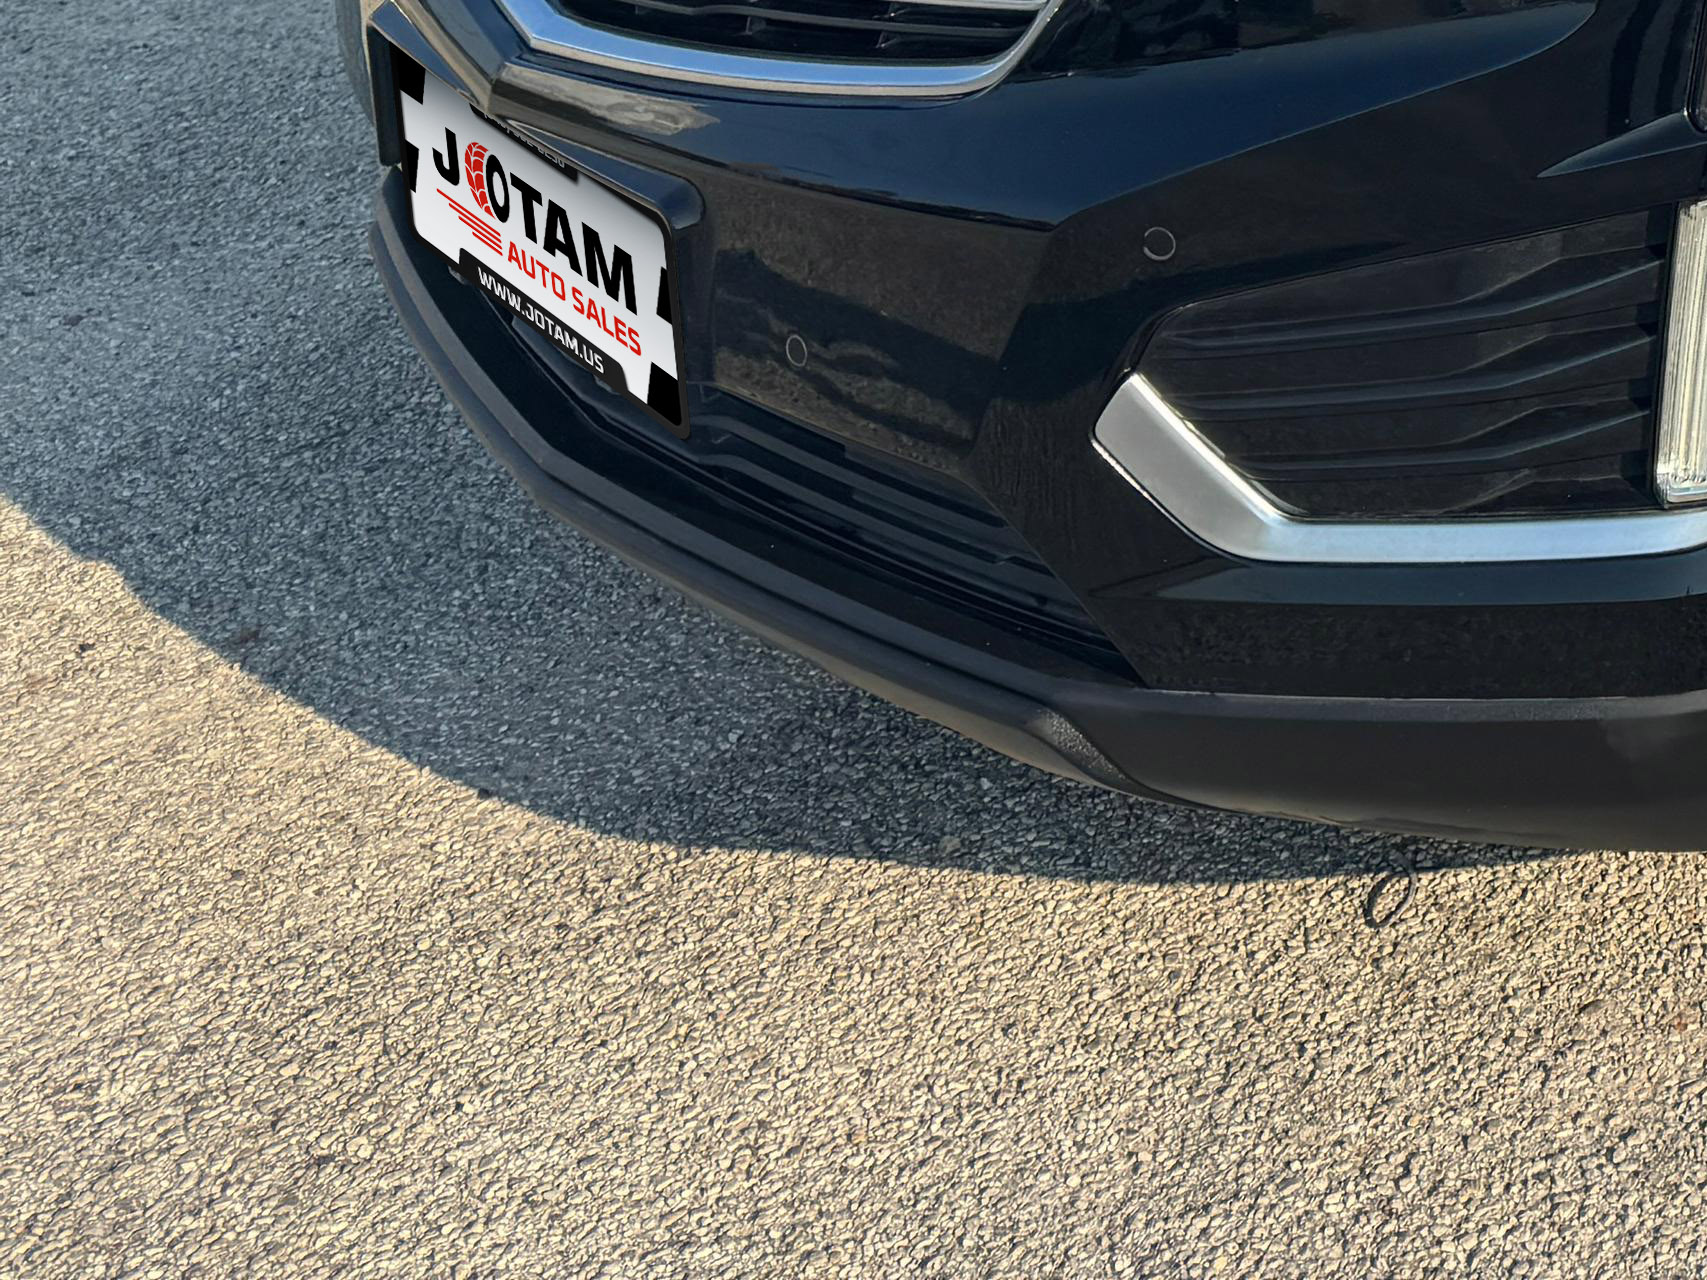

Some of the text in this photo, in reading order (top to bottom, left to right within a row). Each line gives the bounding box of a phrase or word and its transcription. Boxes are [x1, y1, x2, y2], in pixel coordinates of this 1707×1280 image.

[432, 126, 638, 316] JOTAM
[478, 266, 605, 375] WWW.JOTAM.US
[507, 241, 642, 357] AUTO SALES
